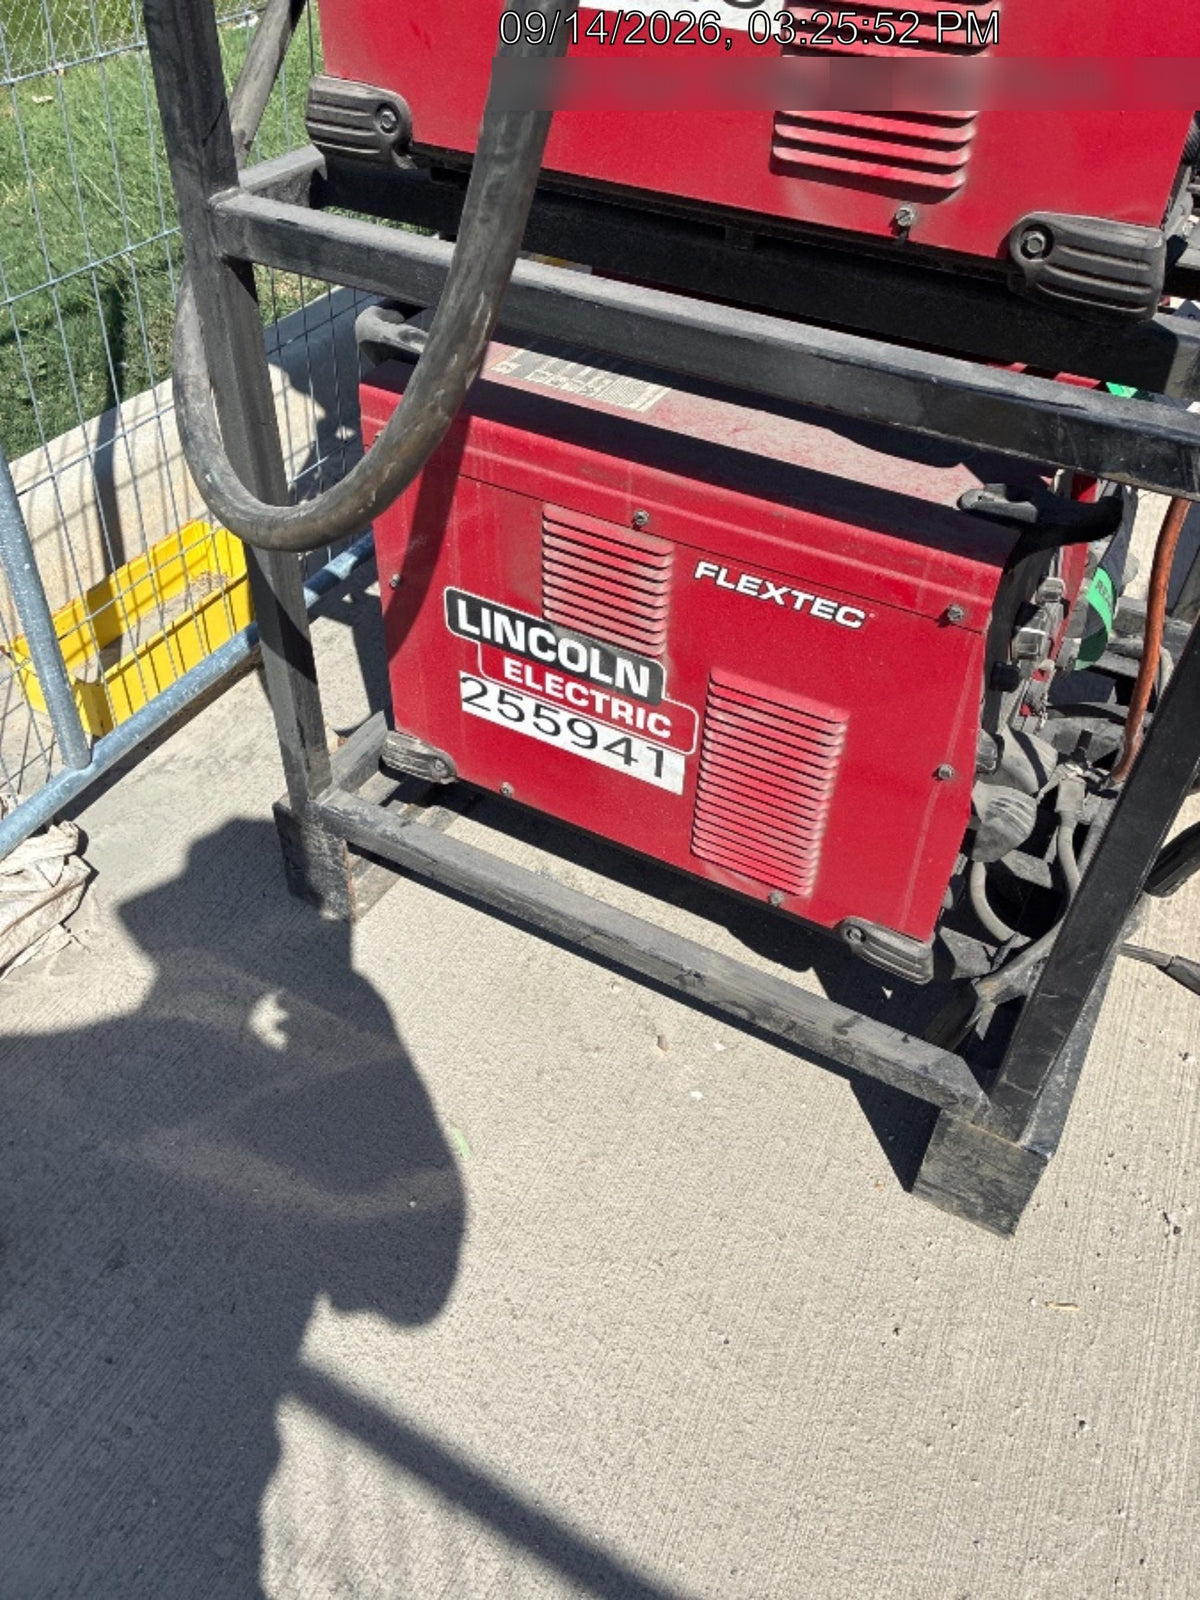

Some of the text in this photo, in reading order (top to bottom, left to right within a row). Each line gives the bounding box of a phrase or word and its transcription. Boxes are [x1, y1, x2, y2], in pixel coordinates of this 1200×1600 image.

[694, 560, 866, 629] FLEXTEC
[457, 598, 650, 698] LINCOLN
[461, 676, 664, 779] 255941
[503, 656, 672, 739] ELECTRIC
